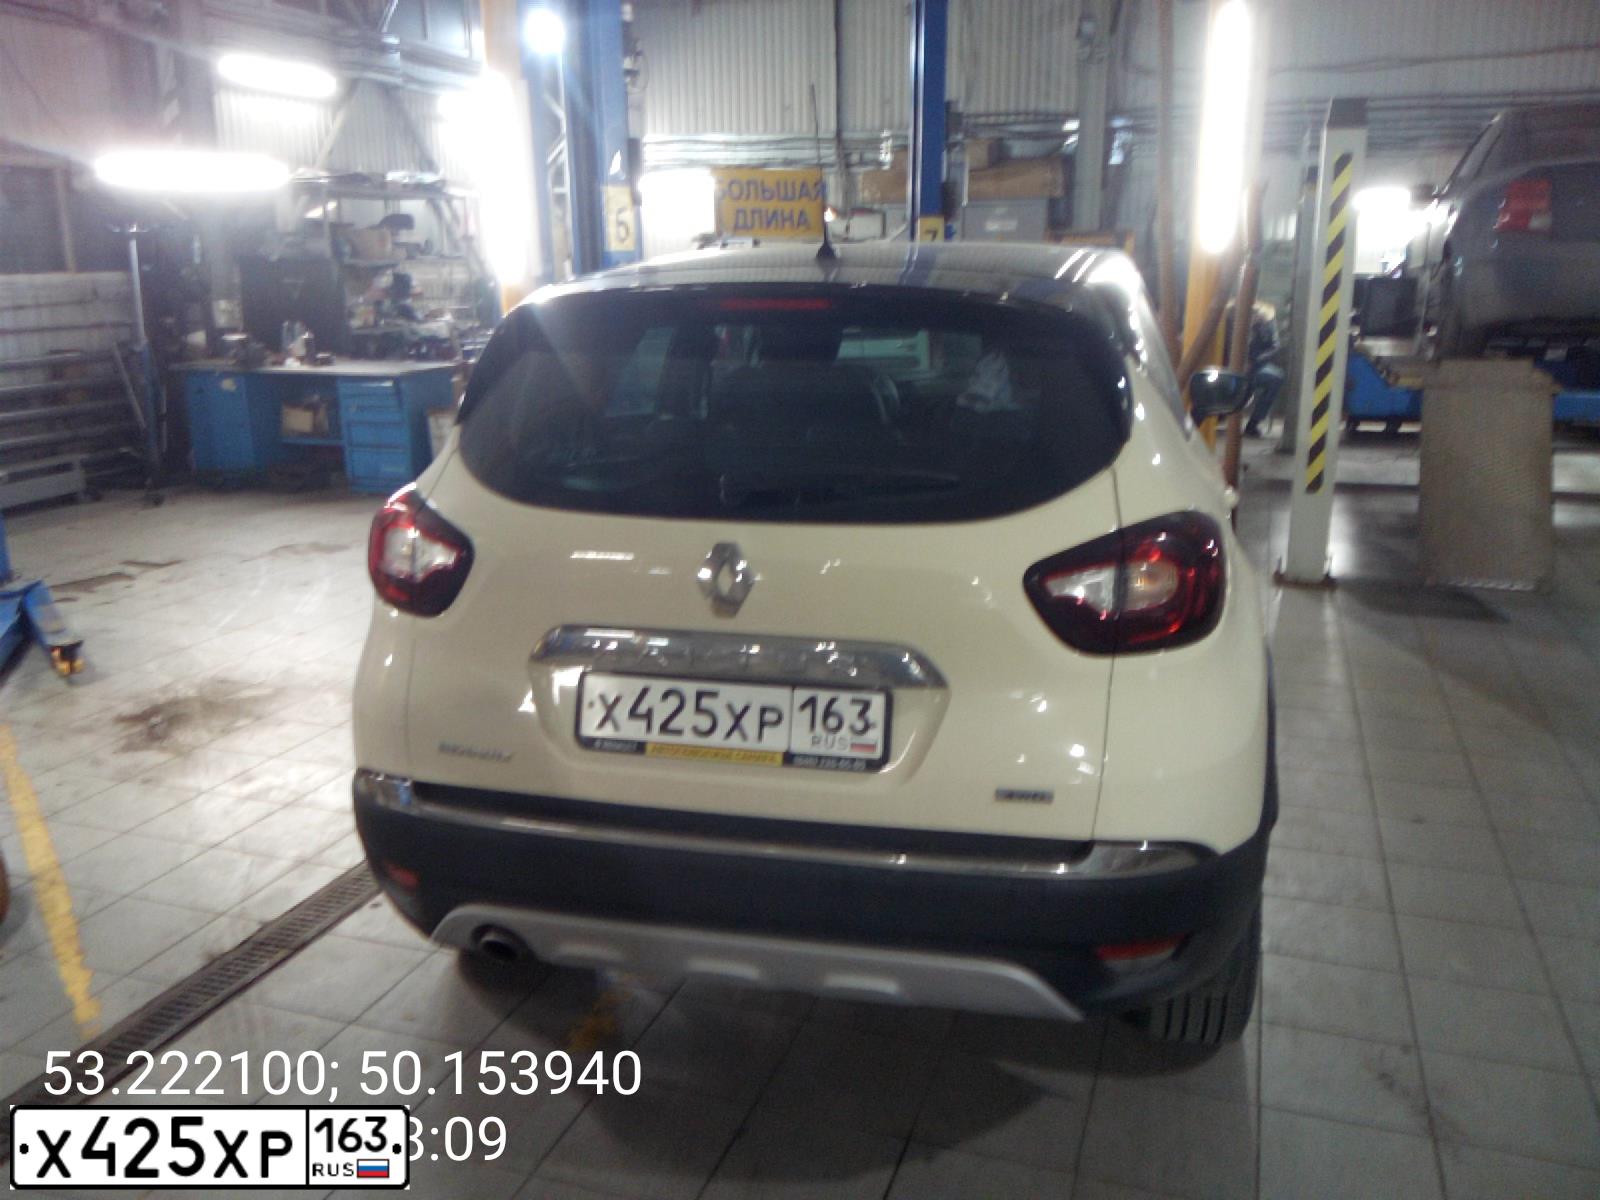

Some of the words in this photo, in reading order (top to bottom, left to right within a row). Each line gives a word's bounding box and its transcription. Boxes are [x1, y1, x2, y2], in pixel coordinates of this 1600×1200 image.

[734, 206, 811, 230] ДЛИНА
[798, 695, 871, 736] 163
[811, 735, 848, 750] RUS
